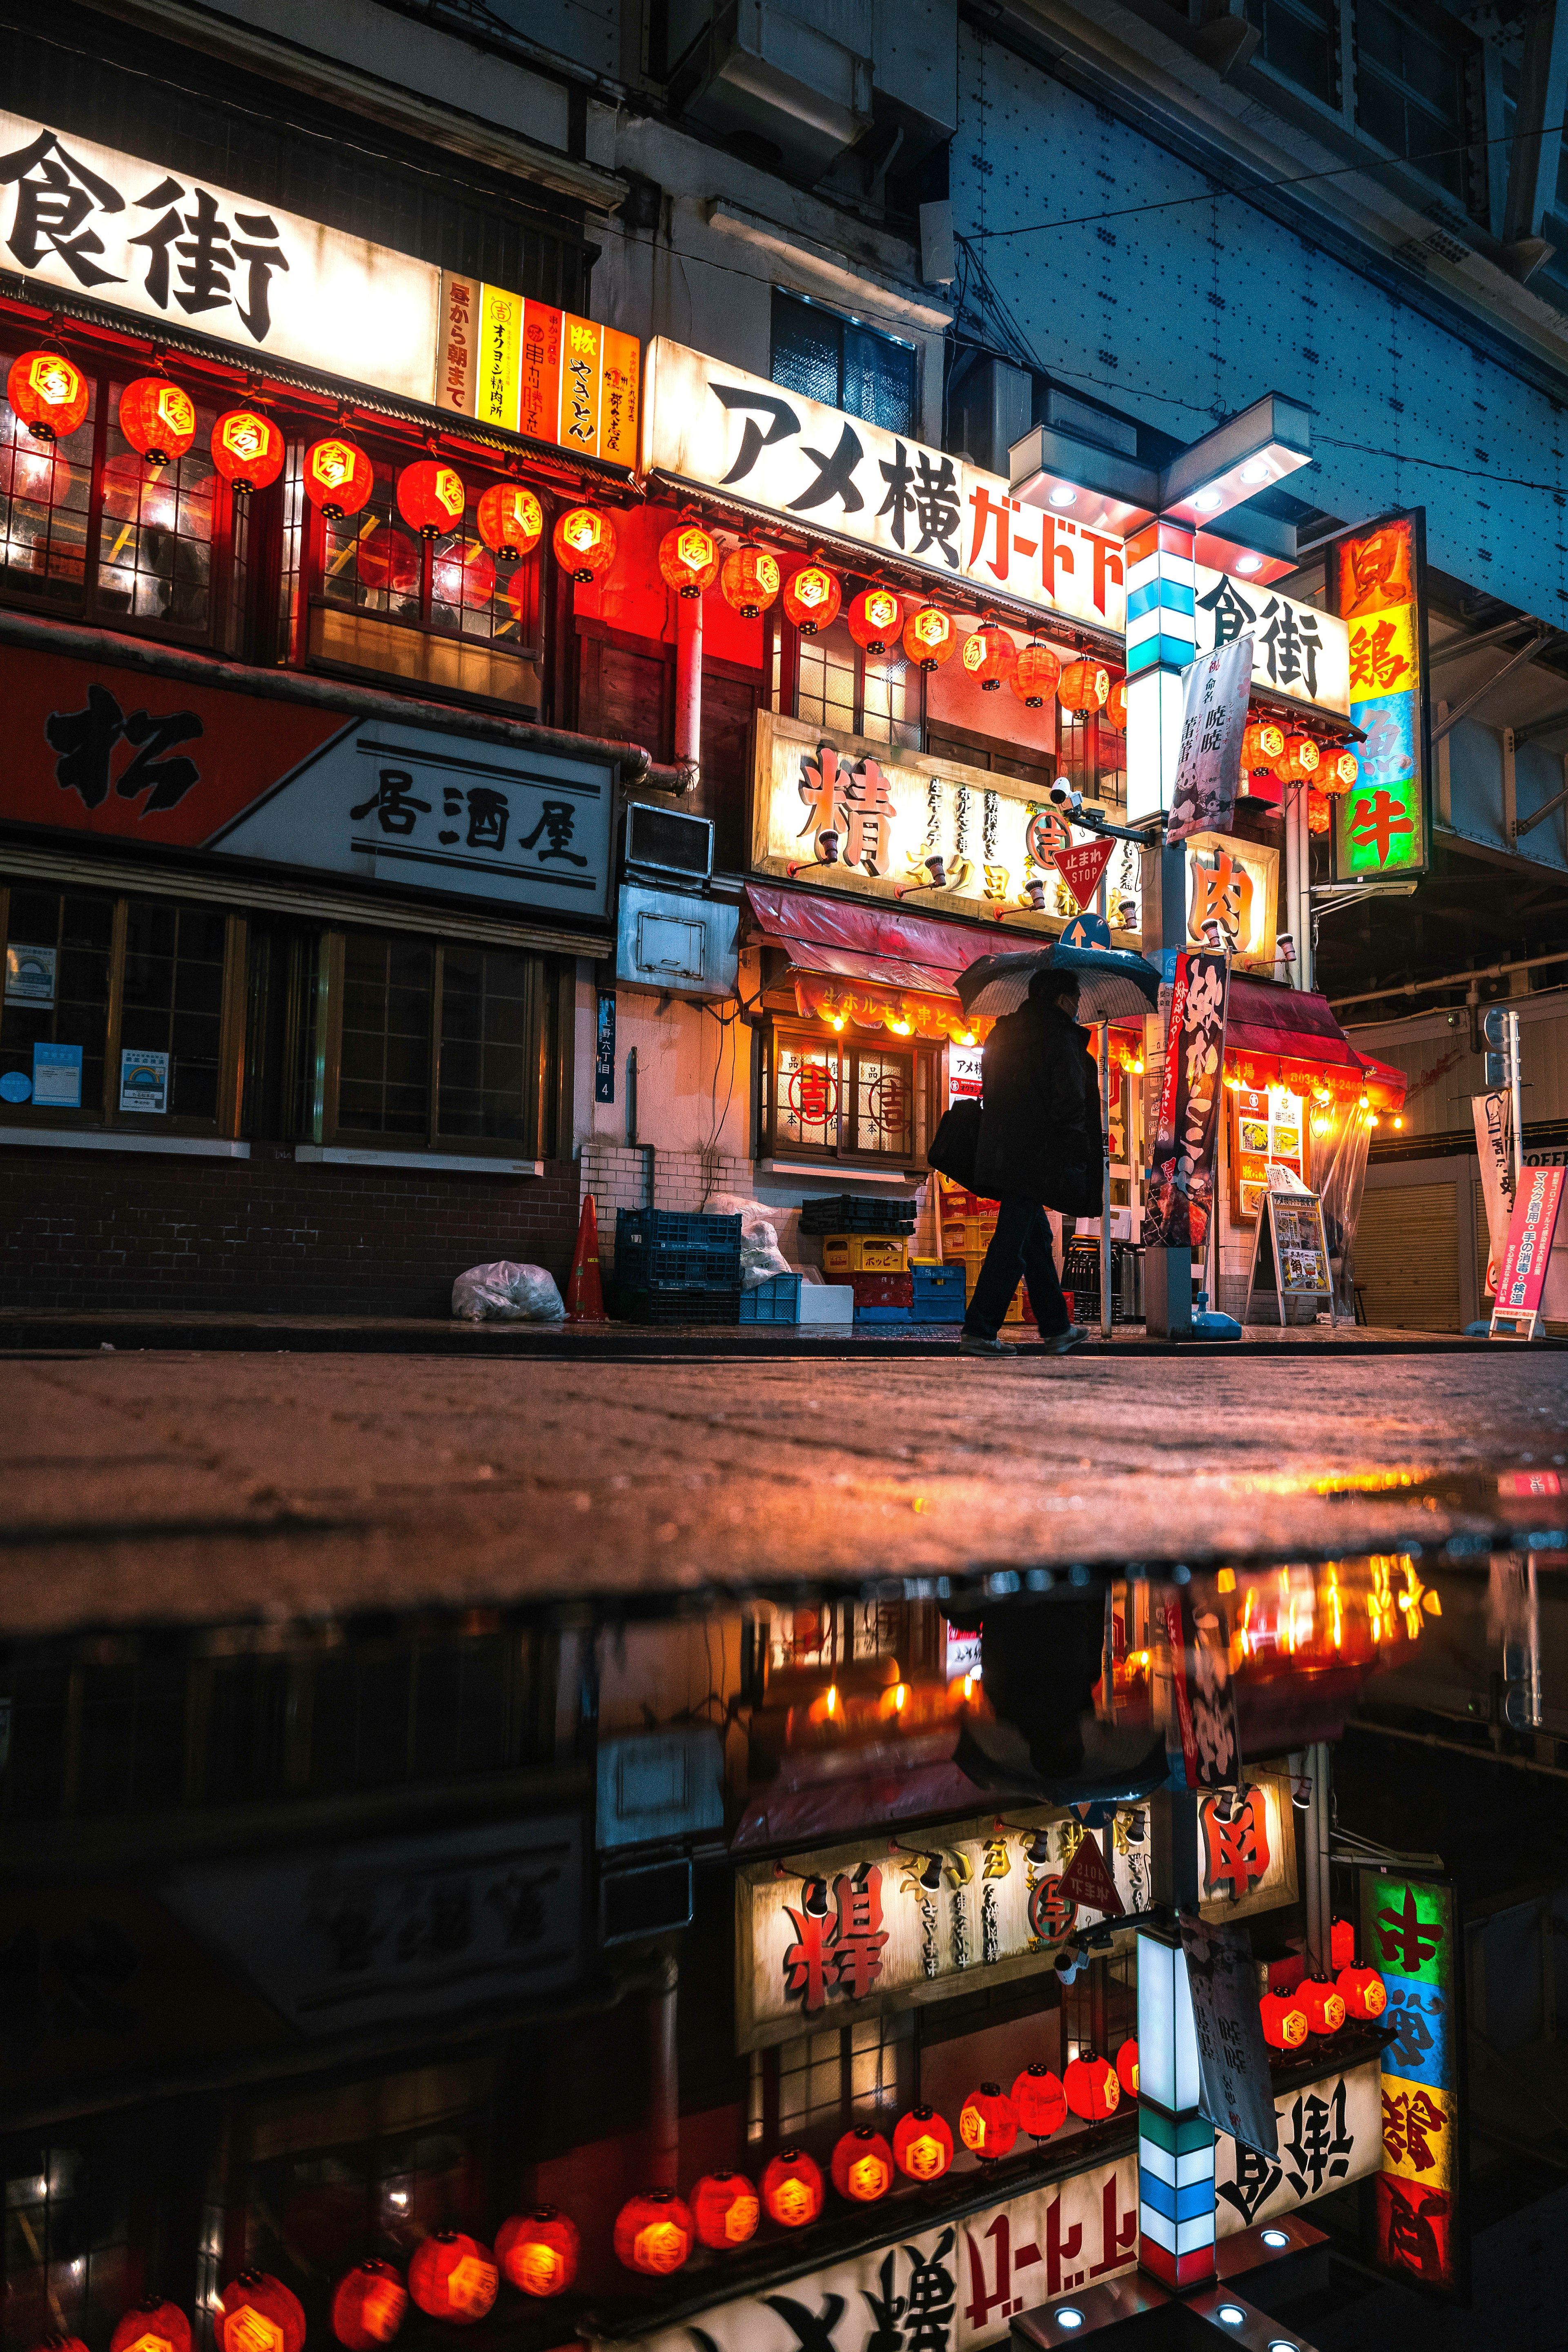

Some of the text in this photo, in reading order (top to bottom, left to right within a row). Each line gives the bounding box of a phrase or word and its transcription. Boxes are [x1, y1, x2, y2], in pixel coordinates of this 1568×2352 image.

[0, 128, 290, 343] 食街
[446, 282, 470, 408] 昼から朝まで
[570, 324, 597, 356] 豚
[490, 324, 506, 419] オクヨシ精肉所
[707, 381, 1324, 699] アメ横 ガード下 食街
[1208, 658, 1221, 674] 祝
[1350, 620, 1410, 690] 鶏
[1202, 677, 1216, 704] 命名
[44, 682, 204, 819] 松
[1222, 702, 1234, 745] シャオシャオ
[1356, 709, 1412, 776] 魚
[349, 769, 589, 868] 居酒屋
[797, 747, 897, 878] 精
[927, 777, 943, 847] 生キムチ
[956, 785, 972, 854] ホルモン串
[1348, 791, 1414, 869] 牛
[1065, 849, 1103, 870] 止まれ
[1072, 867, 1098, 884] STOP
[1188, 849, 1254, 951] 肉
[602, 1017, 611, 1074] 上野六丁目
[788, 1057, 798, 1069] 品
[868, 1066, 878, 1079] 品
[601, 1083, 608, 1096] 4
[1299, 1073, 1363, 1093] 03-684-2468
[787, 1112, 797, 1127] 本
[867, 1121, 878, 1135] 本
[1523, 1152, 1568, 1167] OFF
[865, 1255, 899, 1267] ホッピー
[1510, 1171, 1548, 1305] マスク着用・手の消毒・検温
[1499, 1244, 1516, 1303] 安心安全なお買い物
